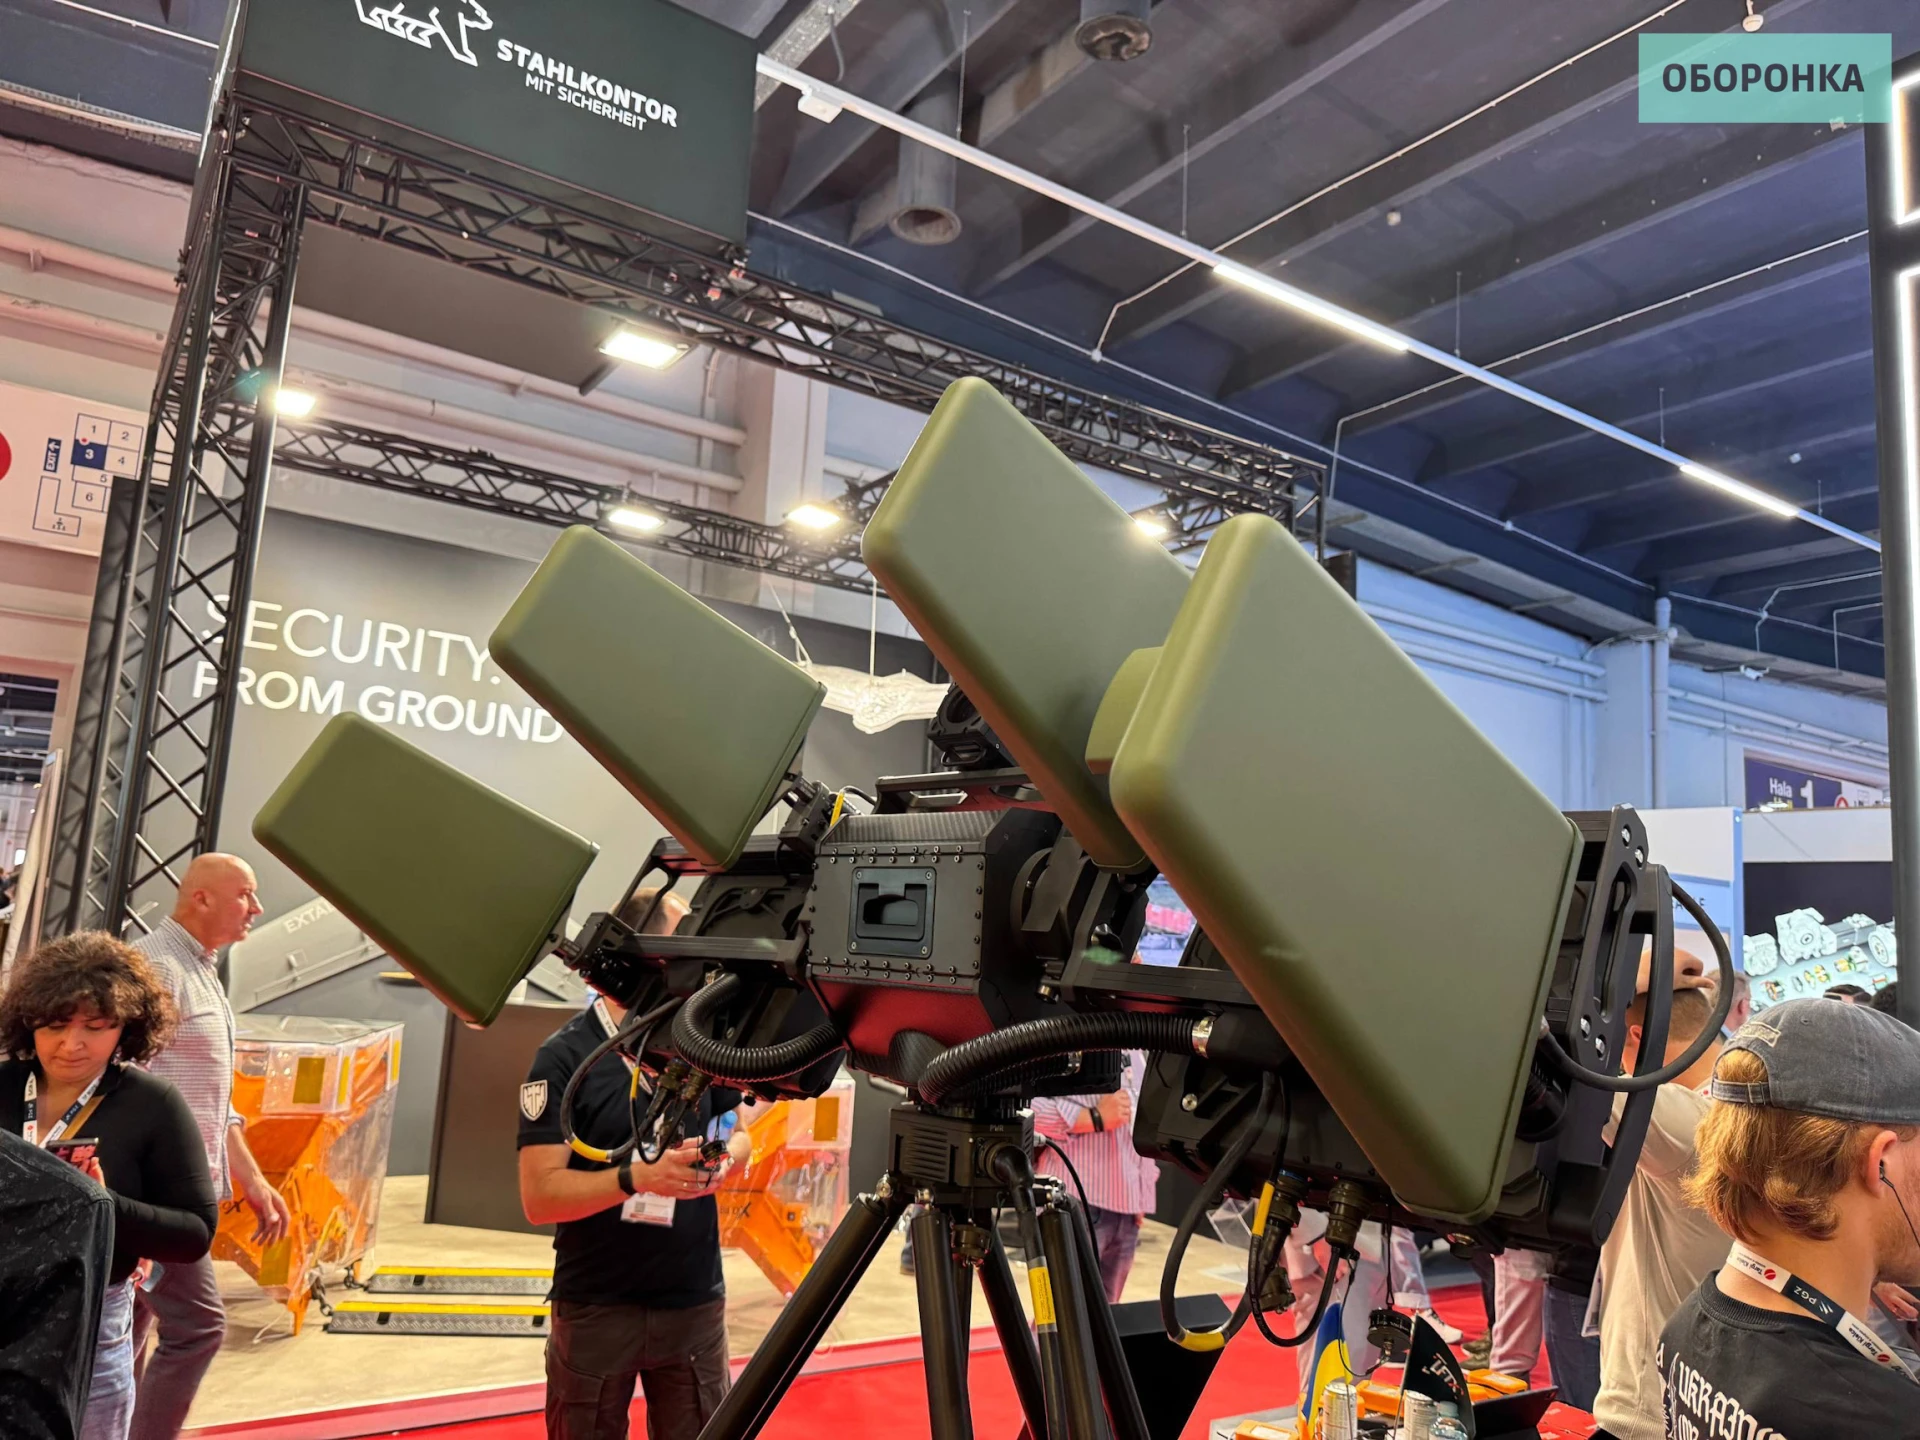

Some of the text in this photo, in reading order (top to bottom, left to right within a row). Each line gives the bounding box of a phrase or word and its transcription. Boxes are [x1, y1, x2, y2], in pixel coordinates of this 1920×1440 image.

[497, 38, 678, 127] STAHLKONTOR
[525, 72, 647, 131] MIT SICHERHEIT
[91, 425, 96, 434] 1
[121, 431, 129, 441] 2
[45, 450, 57, 471] EXIT
[84, 449, 94, 460] 3
[118, 456, 125, 465] 4
[99, 474, 107, 483] 5
[85, 492, 93, 502] 6
[200, 593, 501, 685] SECURITY.
[191, 660, 564, 744] FROM GROUND
[1768, 777, 1814, 809] Hala 1
[989, 1124, 1004, 1132] PWR
[1793, 1285, 1817, 1305] PGZ
